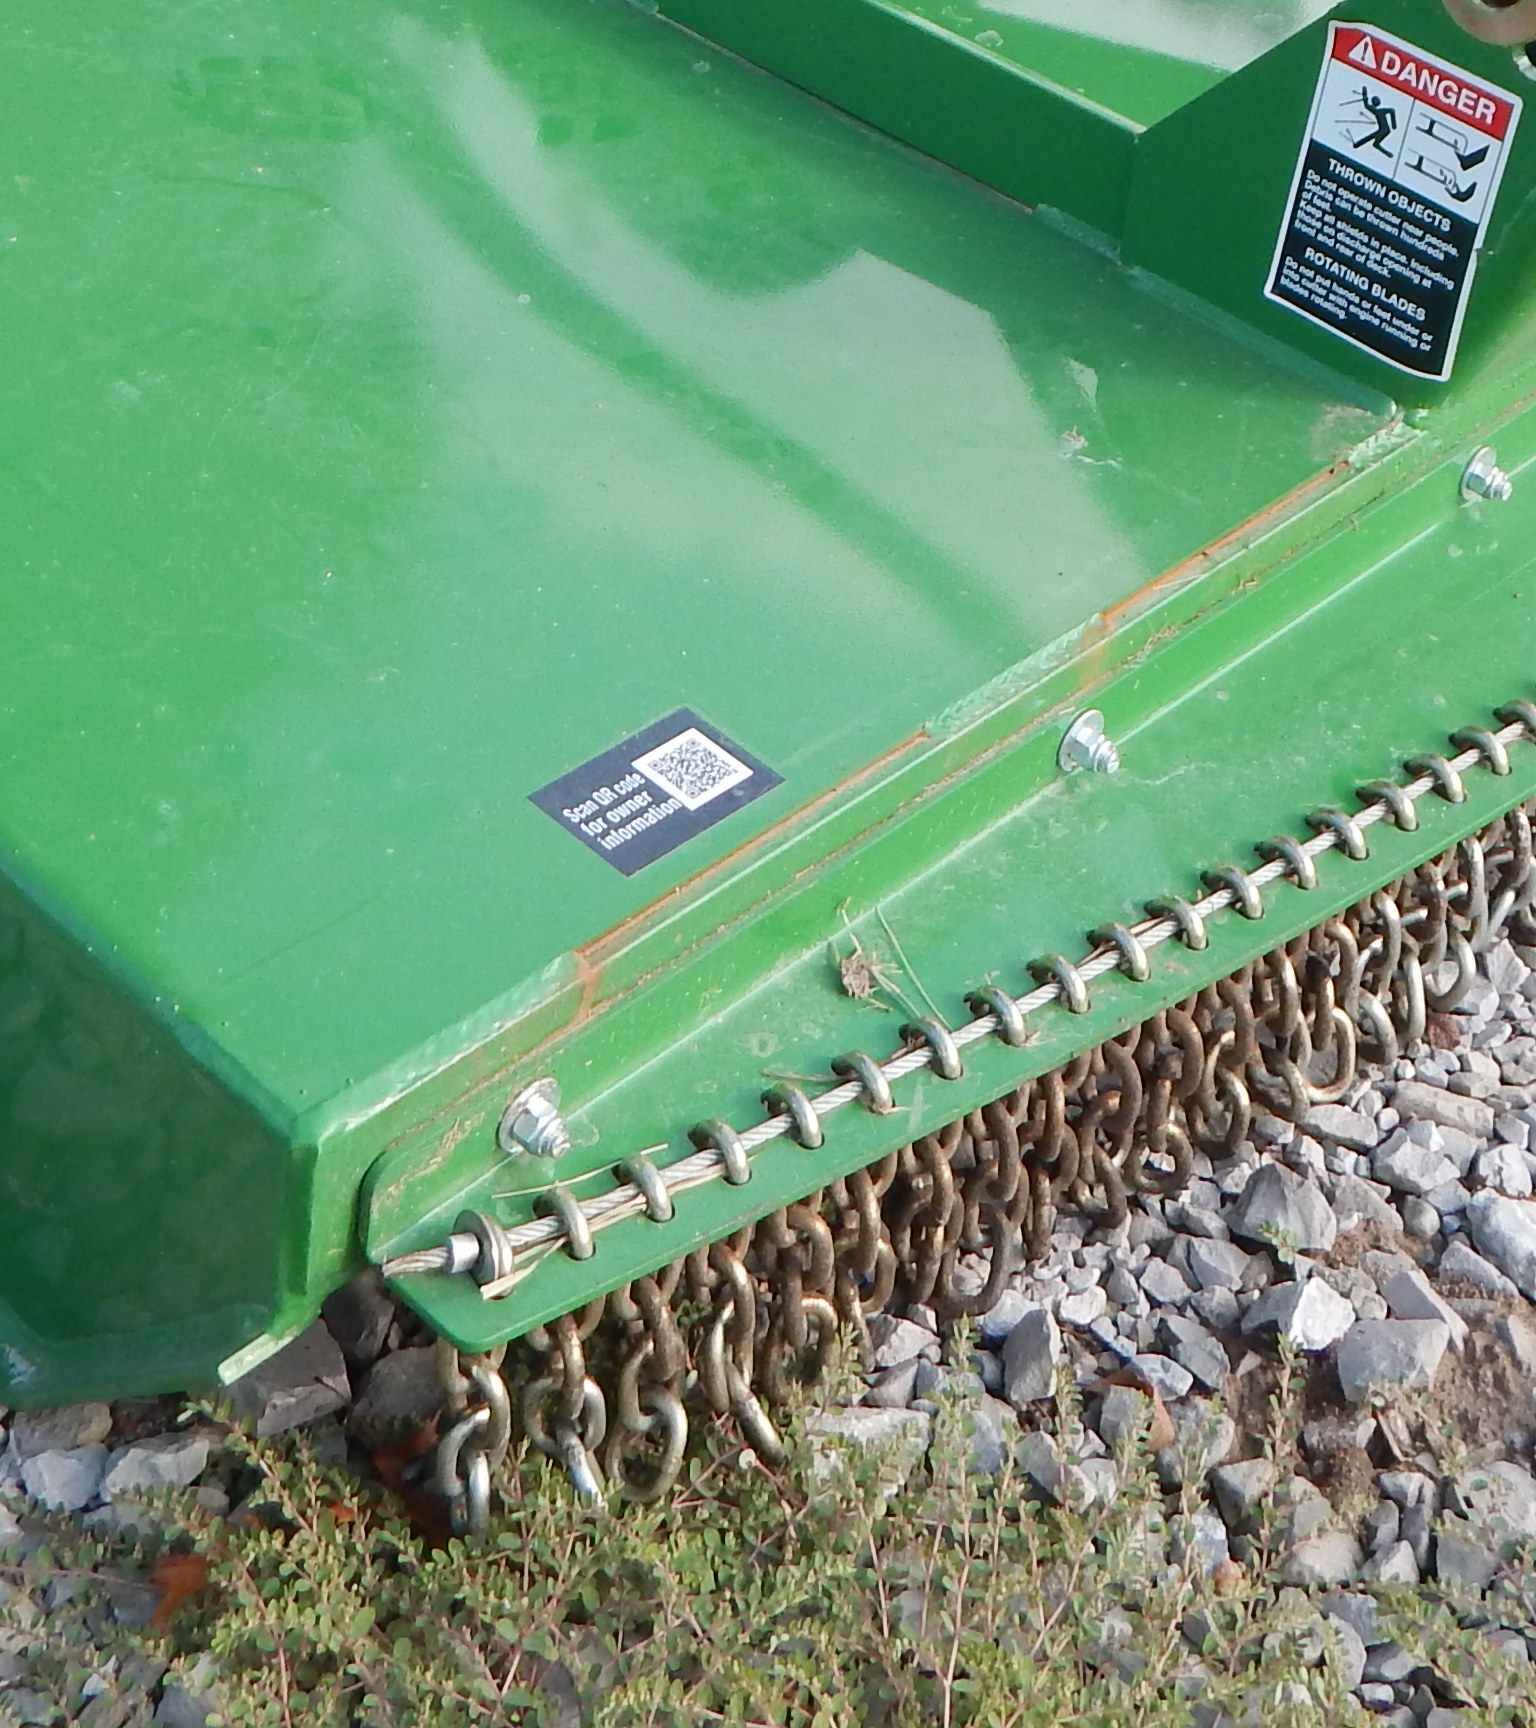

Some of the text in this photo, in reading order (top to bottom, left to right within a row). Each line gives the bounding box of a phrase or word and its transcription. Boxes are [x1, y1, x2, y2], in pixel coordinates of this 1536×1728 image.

[1381, 50, 1498, 125] DANGER
[1328, 157, 1452, 232] THROWN OBJECTS
[1304, 246, 1427, 321] ROTATING BLADES
[562, 773, 646, 823] Scan QR code
[580, 790, 653, 836] for owner
[596, 798, 683, 850] information
